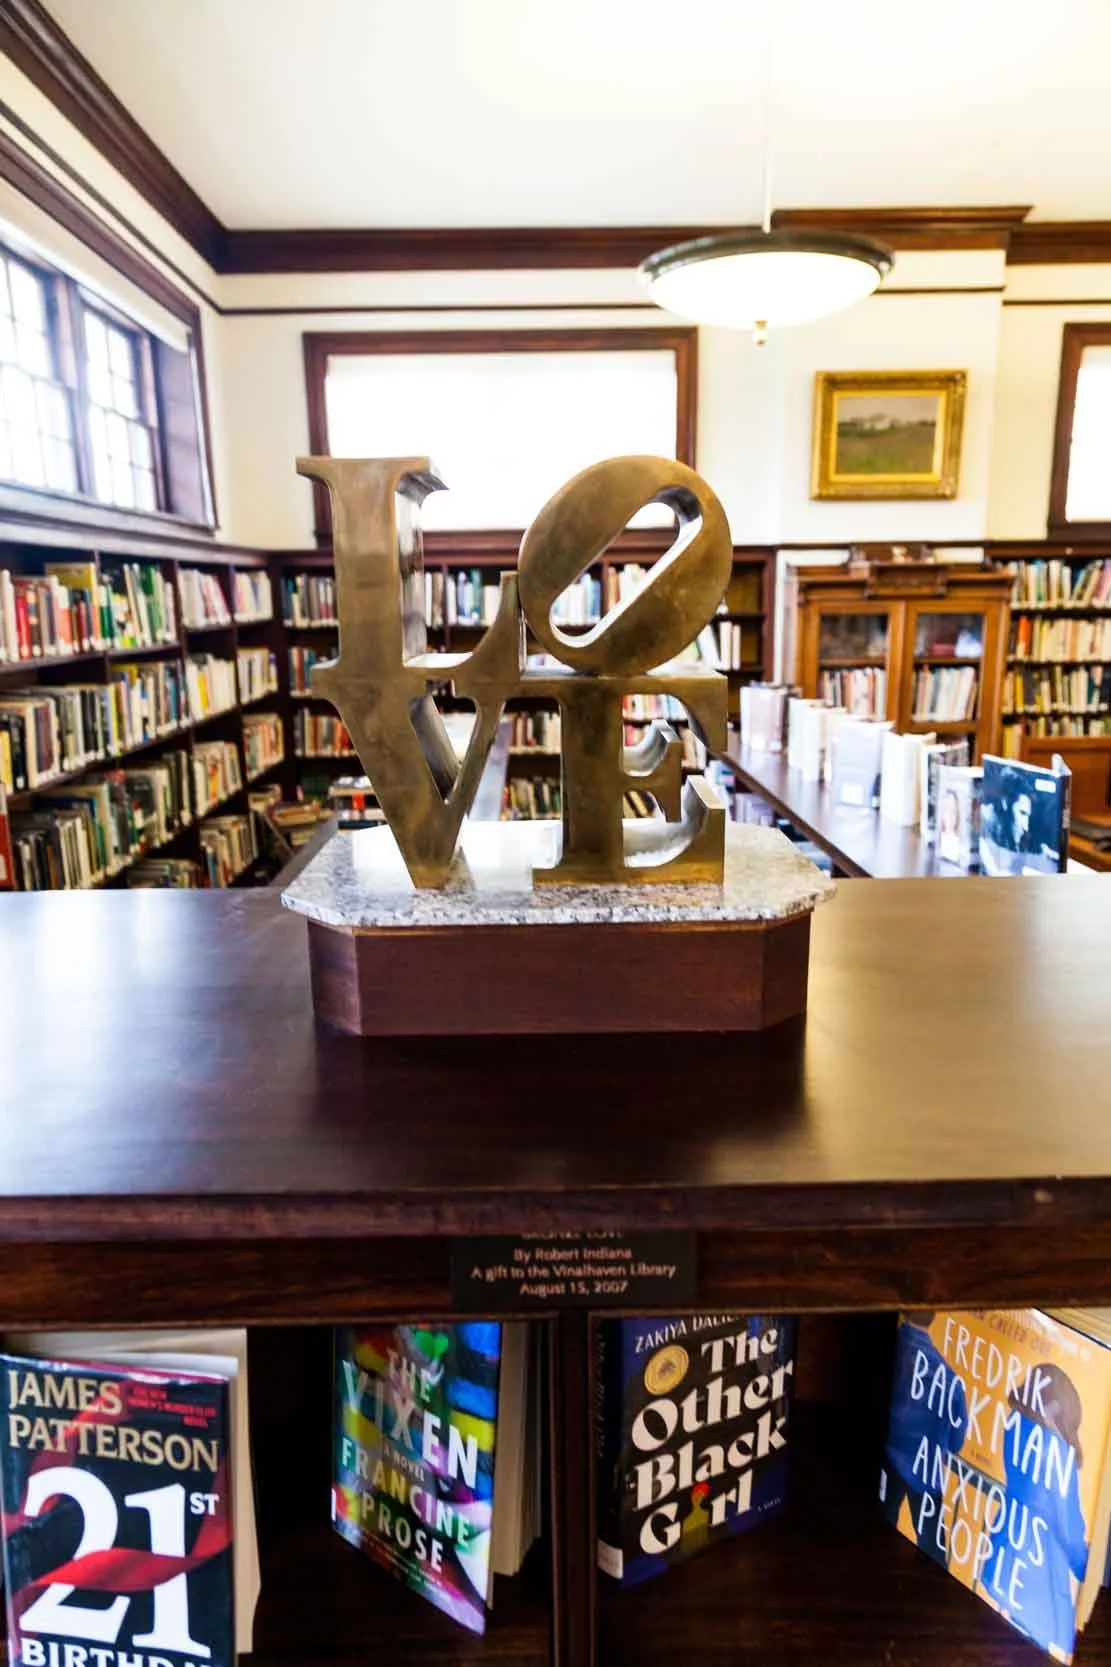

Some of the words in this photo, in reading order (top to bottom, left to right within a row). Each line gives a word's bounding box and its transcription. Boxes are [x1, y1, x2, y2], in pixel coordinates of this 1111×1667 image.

[471, 1266, 483, 1279] A
[485, 1264, 507, 1282] gift
[511, 1266, 525, 1278] to
[527, 1265, 549, 1278] the
[552, 1263, 626, 1278] Vinalhaven
[630, 1261, 676, 1280] Library
[513, 1247, 531, 1265] By
[535, 1247, 578, 1261] Robert
[583, 1246, 632, 1260] Indiana
[520, 1281, 565, 1298] August
[569, 1281, 590, 1296] 15,
[594, 1280, 628, 1294] 2007
[635, 1319, 688, 1354] ZAKIYA
[701, 1327, 779, 1374] The
[943, 1317, 1053, 1418] FREDRIK
[8, 1369, 123, 1416] JAMES
[386, 1348, 434, 1403] THE
[631, 1359, 794, 1452] Other
[8, 1413, 219, 1473] PATTERSON
[342, 1358, 478, 1489] VIXEN
[910, 1349, 1076, 1499] BACKMAN
[342, 1437, 470, 1549] FRANCINE
[393, 1451, 425, 1482] NOVEL
[632, 1409, 788, 1512] Black
[361, 1492, 443, 1574] PROSE
[912, 1435, 1048, 1568] ANXIOUS
[917, 1491, 1028, 1611] PEOPLE
